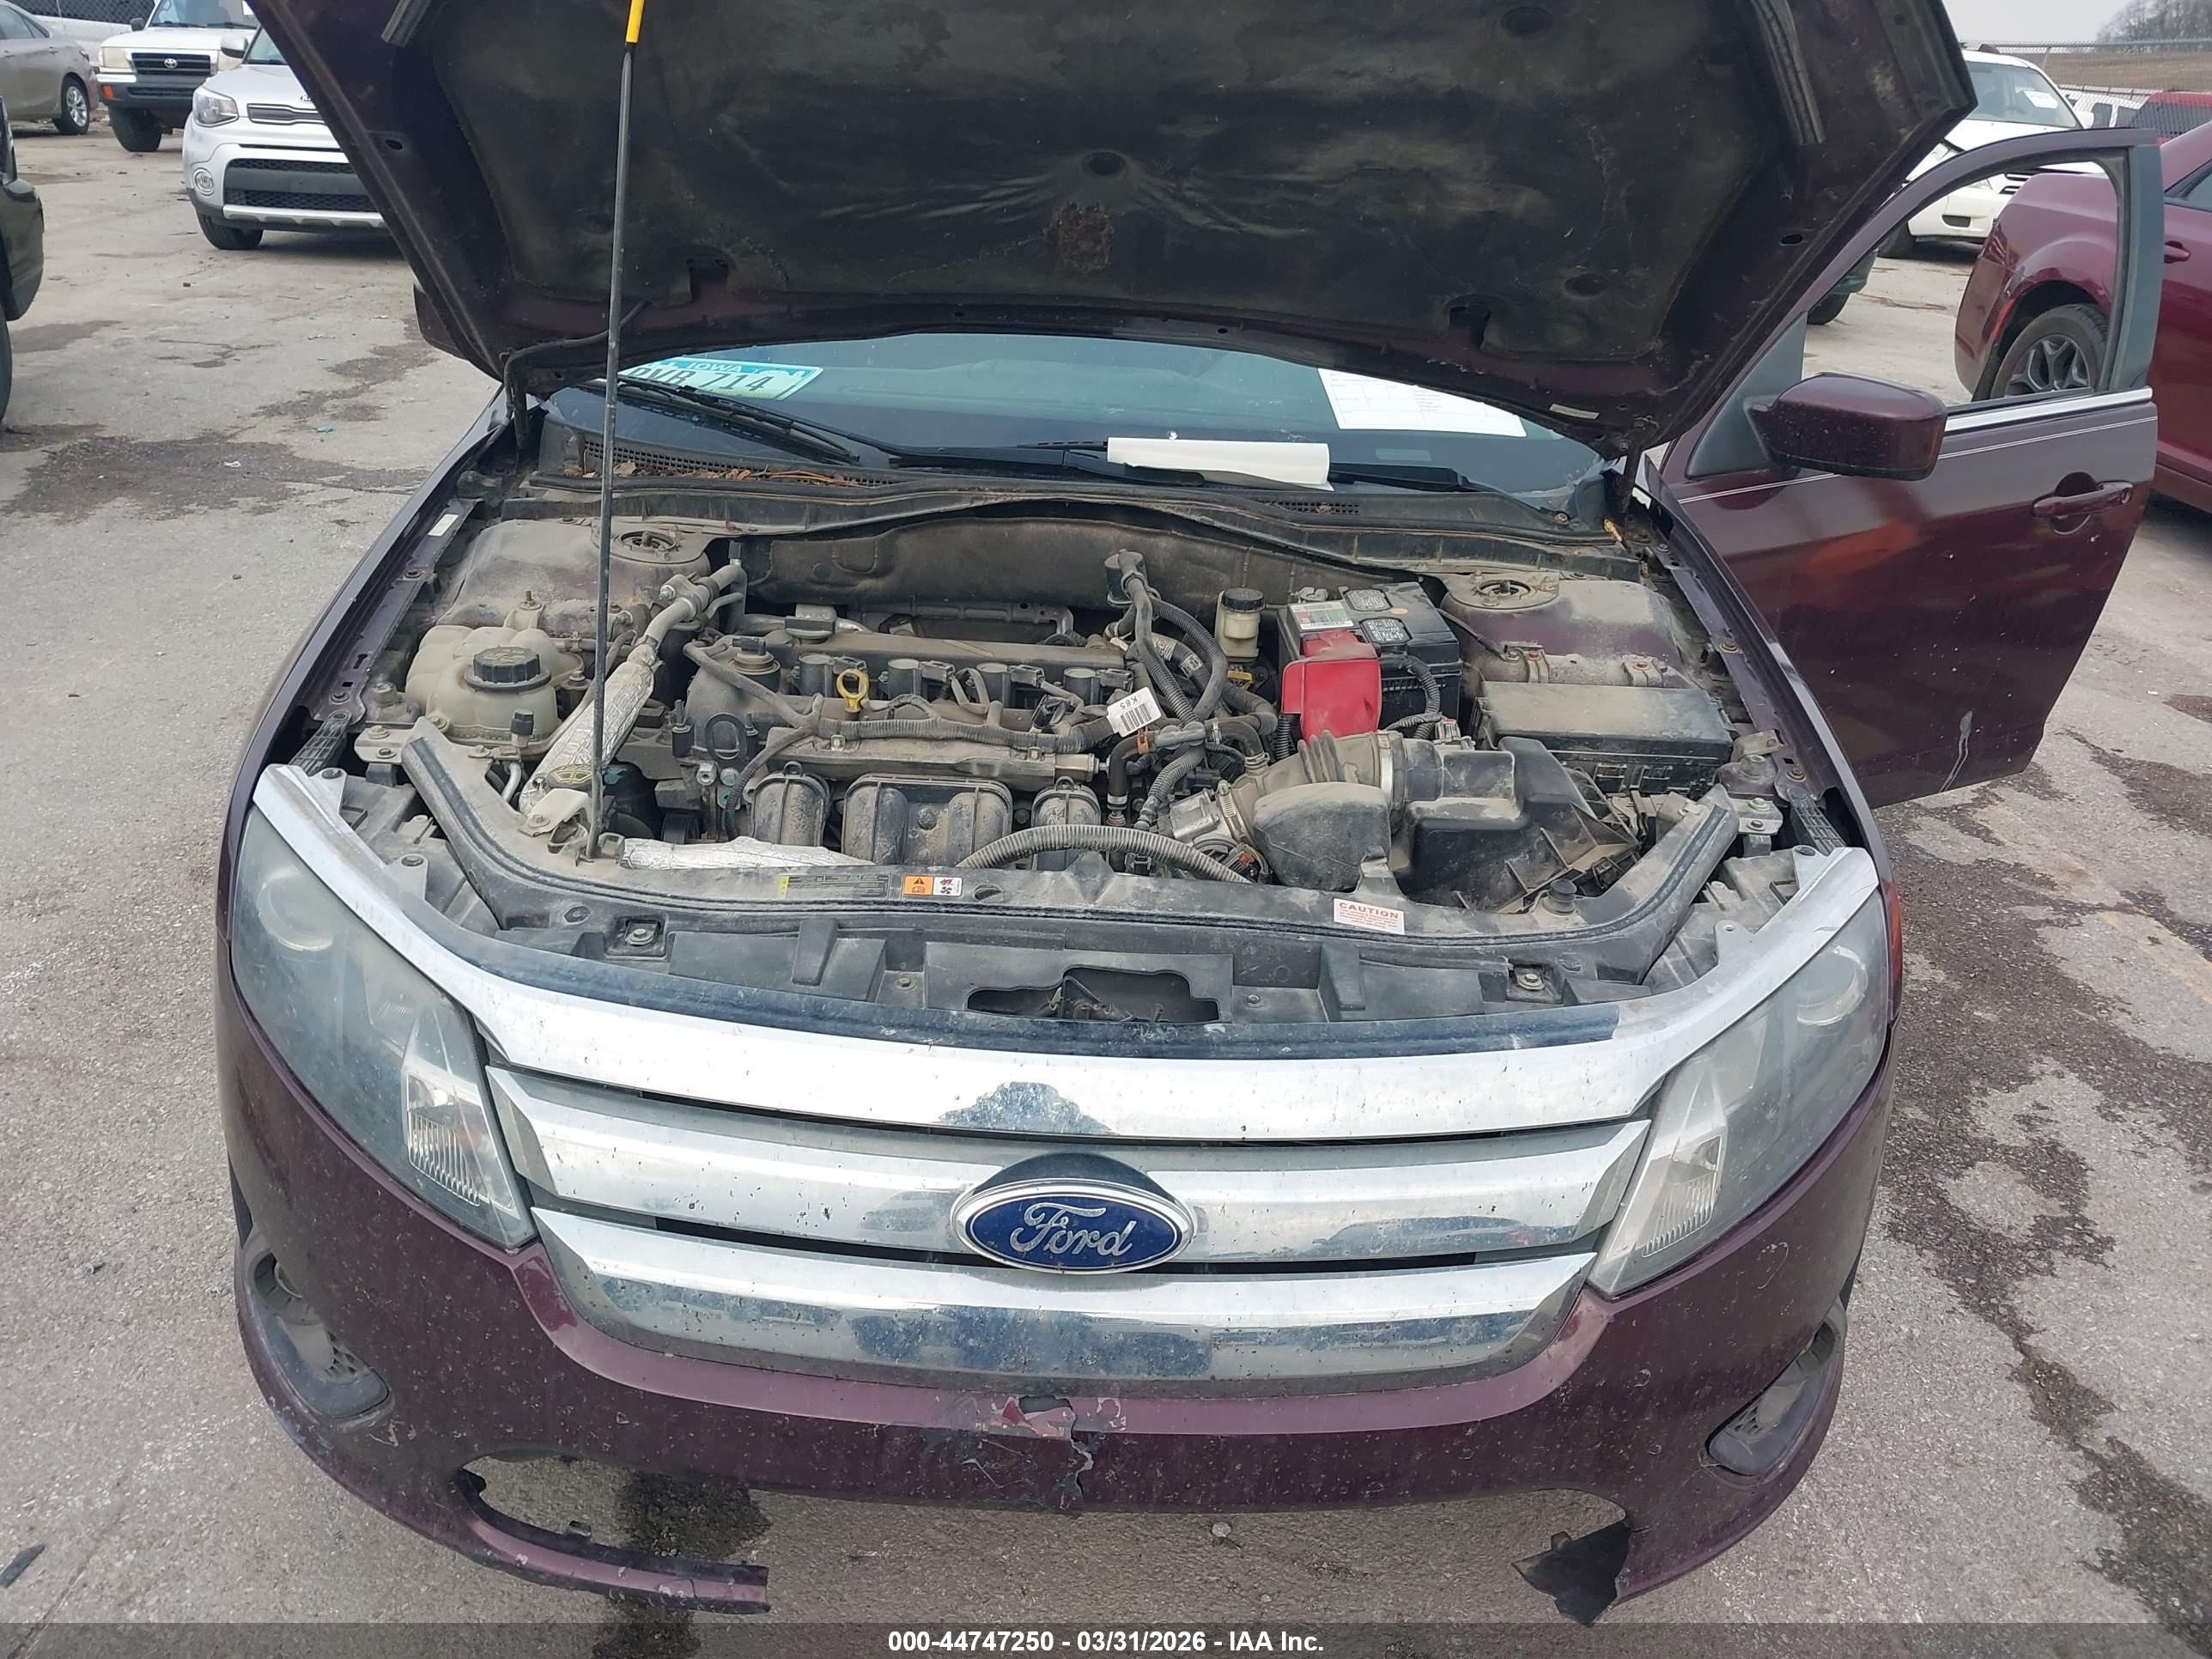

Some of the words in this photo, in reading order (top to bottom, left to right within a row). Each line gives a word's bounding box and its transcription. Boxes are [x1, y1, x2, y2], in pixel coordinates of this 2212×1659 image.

[686, 362, 743, 373] IOWA
[698, 372, 775, 391] 714
[1339, 902, 1399, 919] CAUTION
[1009, 1201, 1137, 1257] Ford
